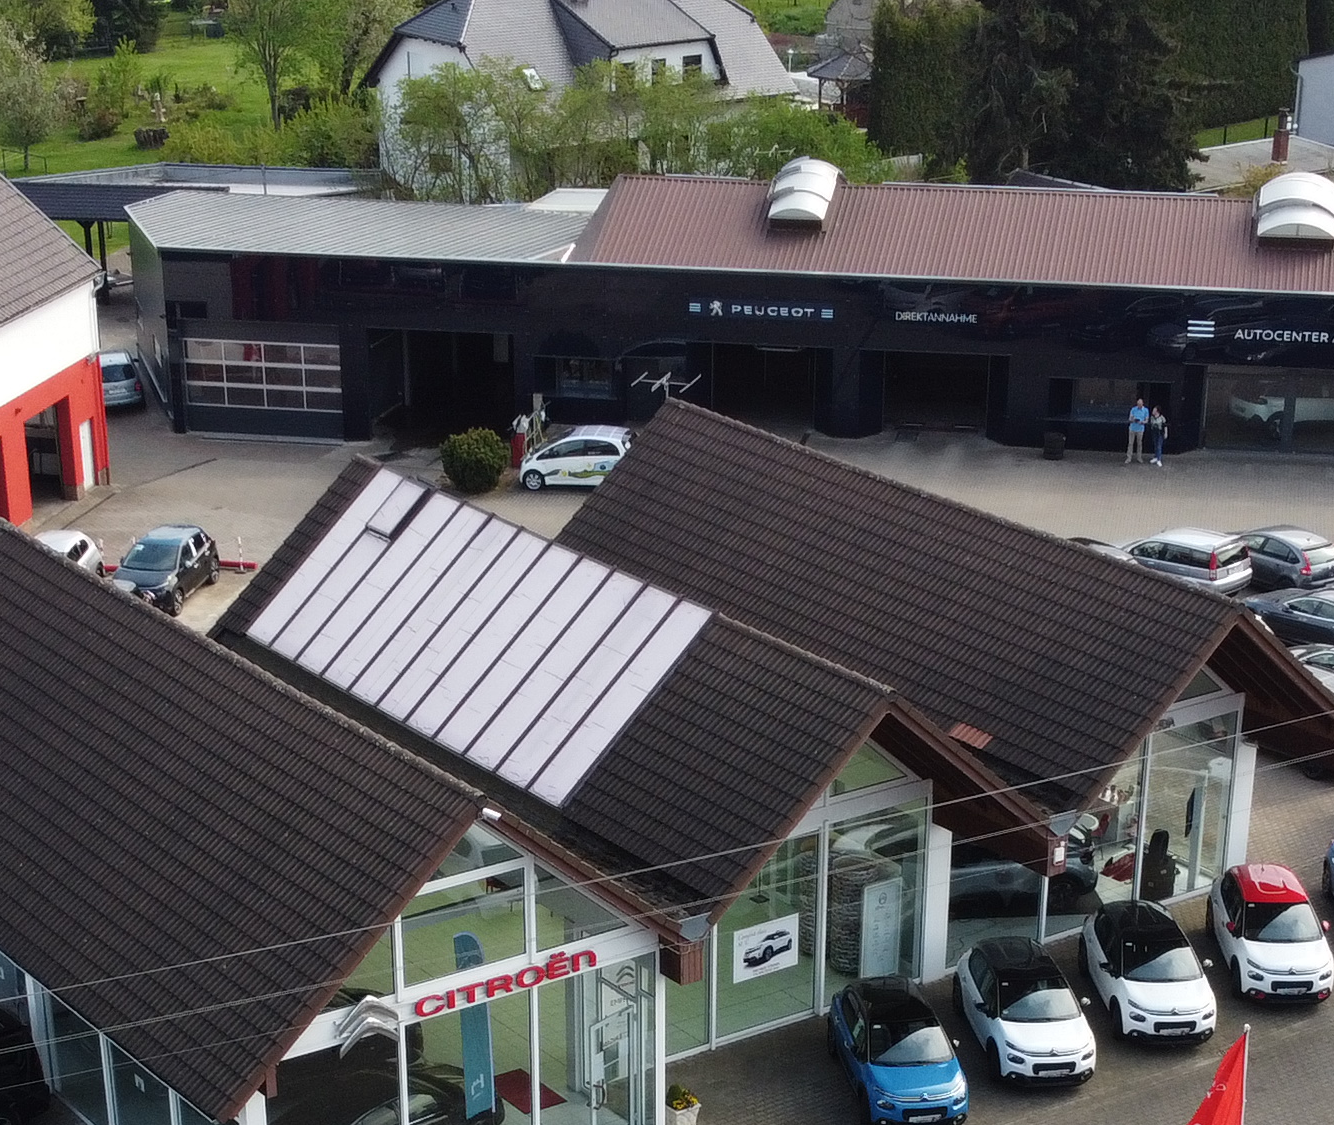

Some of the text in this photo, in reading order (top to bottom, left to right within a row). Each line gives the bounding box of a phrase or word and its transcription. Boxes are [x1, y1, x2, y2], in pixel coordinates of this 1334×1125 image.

[731, 304, 815, 317] PEUGEOT
[895, 311, 978, 324] DIREKTANNAHME
[1234, 328, 1329, 343] AUTOCENTER
[414, 950, 598, 1018] CITROËN
